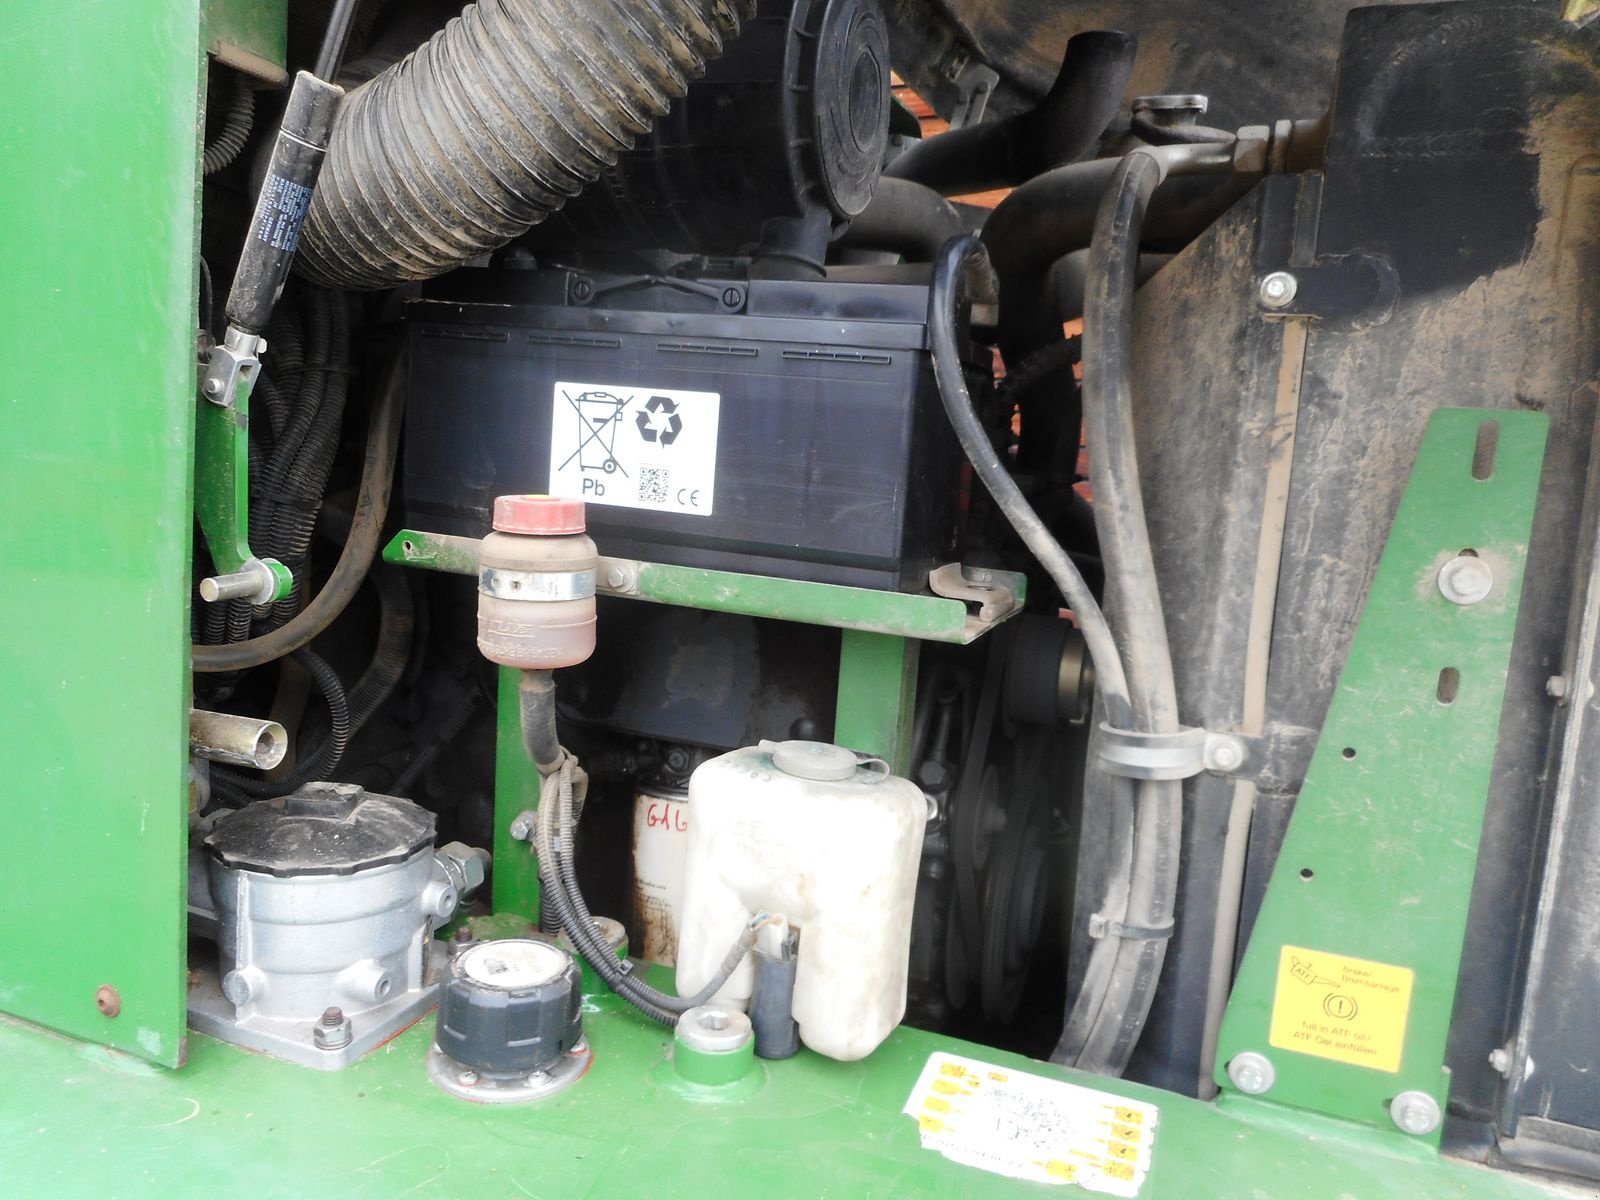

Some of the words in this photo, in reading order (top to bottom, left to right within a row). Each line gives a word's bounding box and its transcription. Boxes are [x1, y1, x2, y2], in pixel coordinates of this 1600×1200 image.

[582, 477, 605, 496] Pb
[1292, 1031, 1313, 1041] ATF
[1330, 1026, 1350, 1037] ATF
